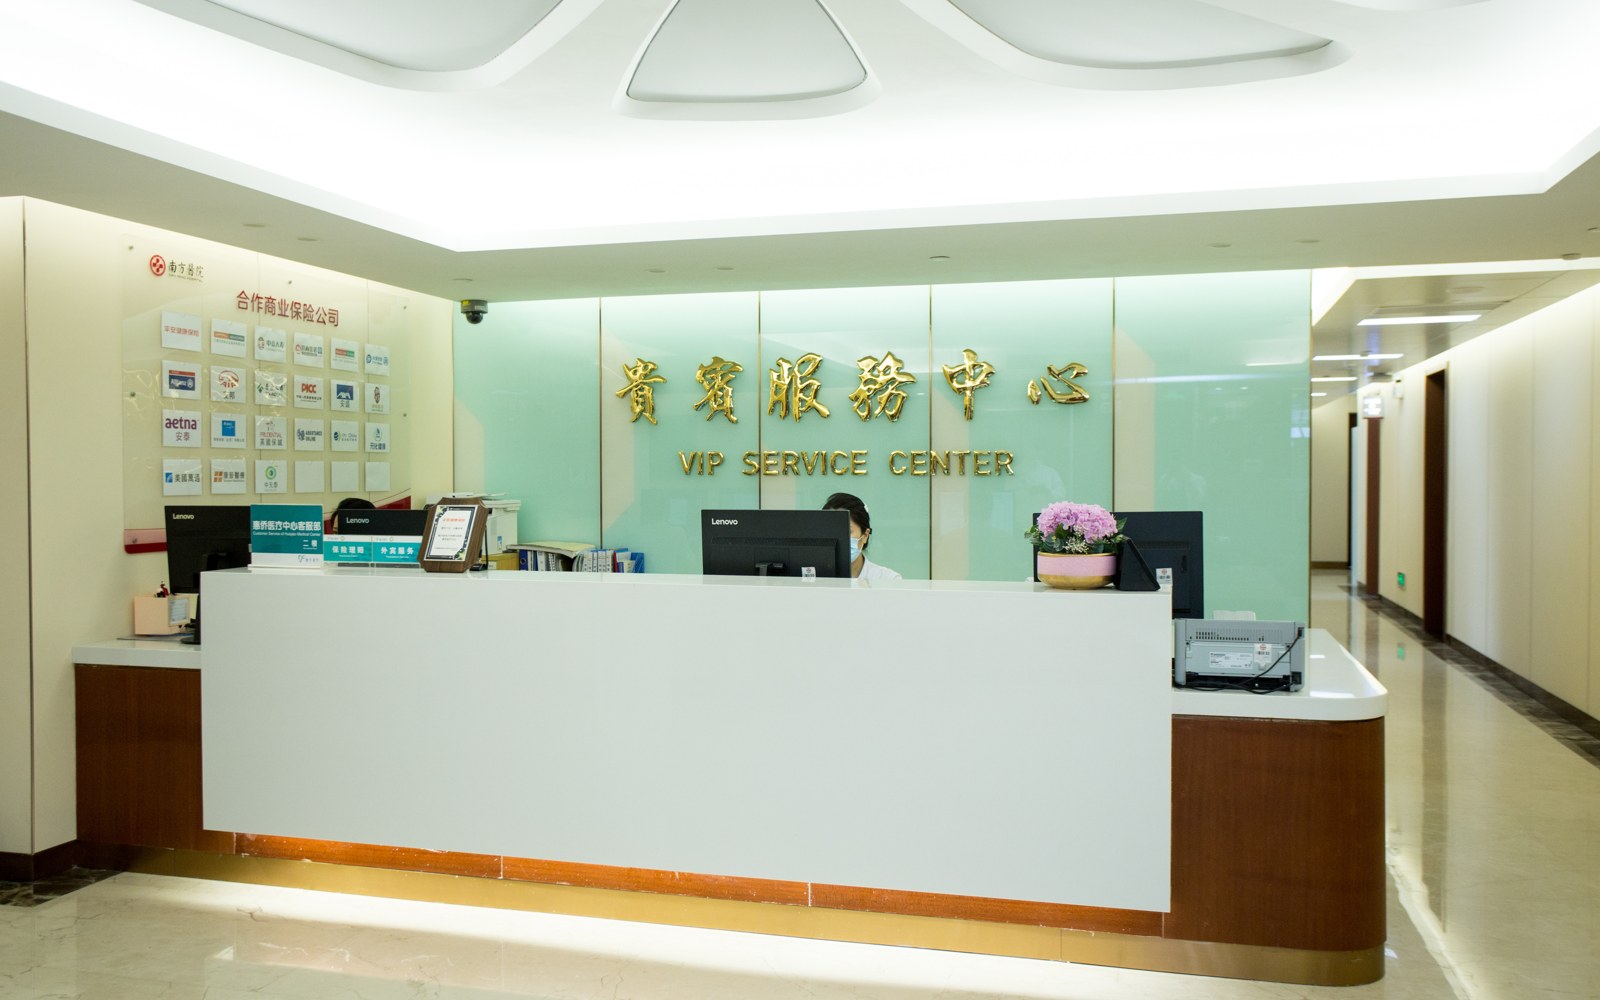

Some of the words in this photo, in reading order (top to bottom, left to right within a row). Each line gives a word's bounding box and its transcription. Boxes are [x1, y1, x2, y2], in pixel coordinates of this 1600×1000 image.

[236, 290, 339, 327] 合作商业保险公司
[301, 383, 317, 394] PICC
[616, 348, 1090, 425] 貴賓服務中心
[165, 417, 197, 430] aetna
[678, 450, 724, 476] VIP
[742, 450, 868, 476] SERVICE
[888, 450, 1015, 476] CENTER
[711, 518, 738, 526] Lenovo
